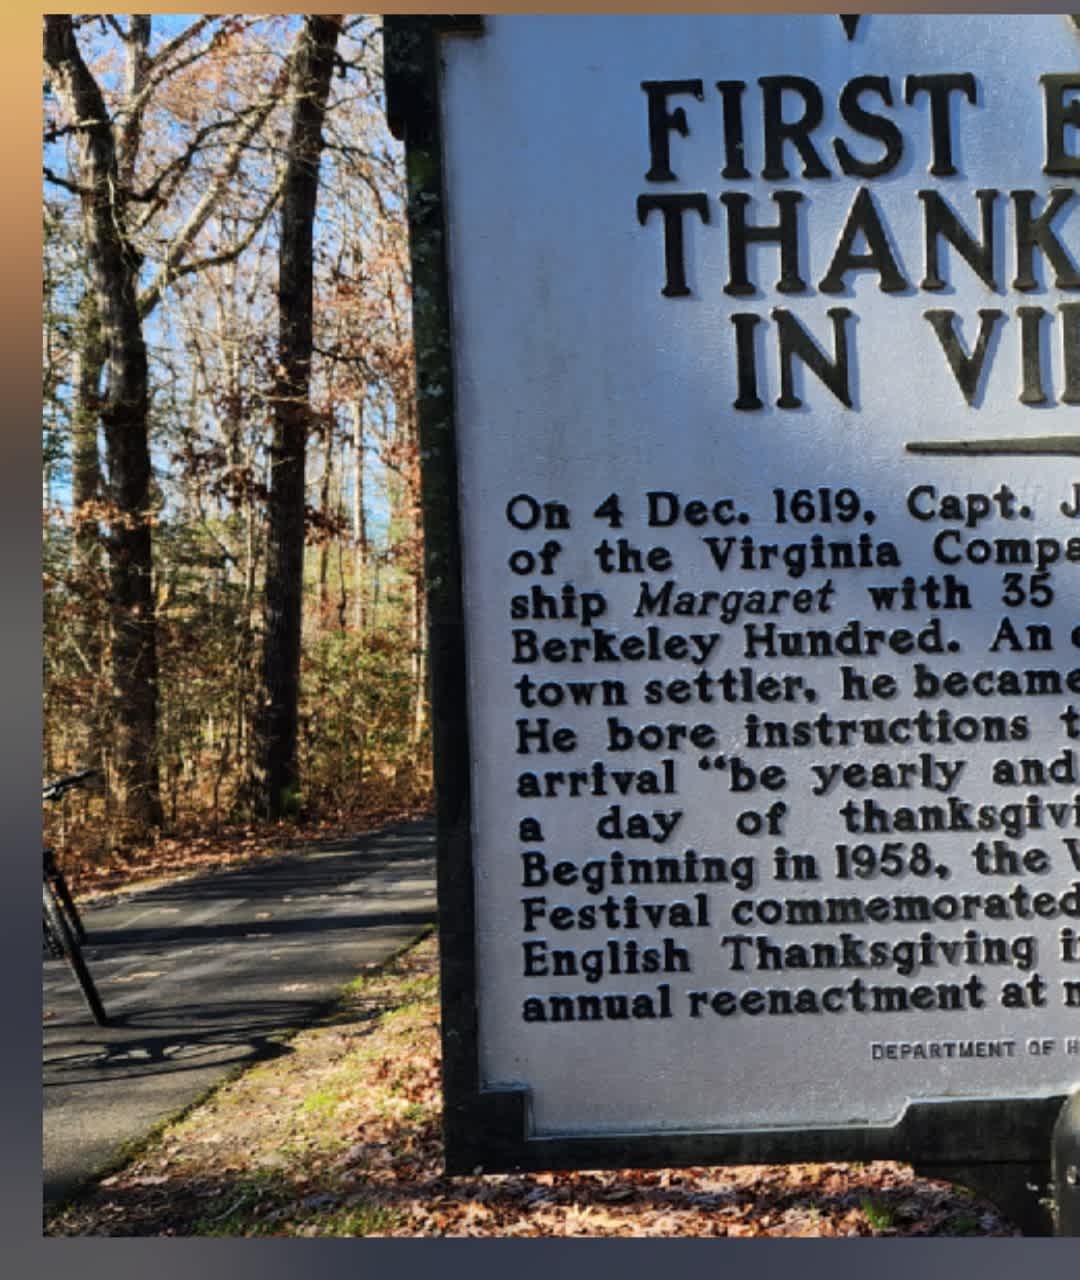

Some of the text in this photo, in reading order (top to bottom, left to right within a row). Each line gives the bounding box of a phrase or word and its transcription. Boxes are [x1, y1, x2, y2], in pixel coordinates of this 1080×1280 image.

[641, 73, 977, 184] FIRST
[731, 308, 857, 413] IN
[506, 494, 570, 530] On
[594, 493, 623, 528] 4
[646, 492, 750, 527] Dec.
[907, 485, 1031, 529] Capt.
[509, 540, 562, 575] of
[596, 539, 672, 574] the
[703, 536, 901, 577] Virginia
[511, 585, 608, 626] ship
[634, 580, 835, 624] Margaret
[868, 574, 972, 610] with
[1002, 571, 1054, 608] 35
[512, 626, 720, 665] Berkeley
[744, 619, 960, 659] Hundred.
[990, 618, 1053, 652] An
[515, 678, 628, 708] town
[841, 666, 897, 701] he
[516, 719, 577, 754] He
[608, 718, 716, 752] bore
[745, 709, 1029, 749] instructions
[517, 760, 675, 798] arrival
[699, 756, 786, 792] “be
[812, 753, 966, 796] yearly
[993, 751, 1076, 786] and
[520, 818, 544, 842] a
[597, 805, 683, 844] day
[736, 801, 787, 836] of
[521, 851, 754, 893] Beginning
[774, 847, 820, 881] in
[972, 841, 1050, 874] the
[521, 893, 710, 932] Festival
[522, 938, 691, 983] English
[721, 930, 1035, 976] Thanksgiving
[522, 984, 672, 1023] annual
[688, 976, 984, 1018] reenactment
[1002, 975, 1046, 1008] at
[872, 1041, 1016, 1061] DEPARTMENT
[1029, 1040, 1055, 1056] OF
